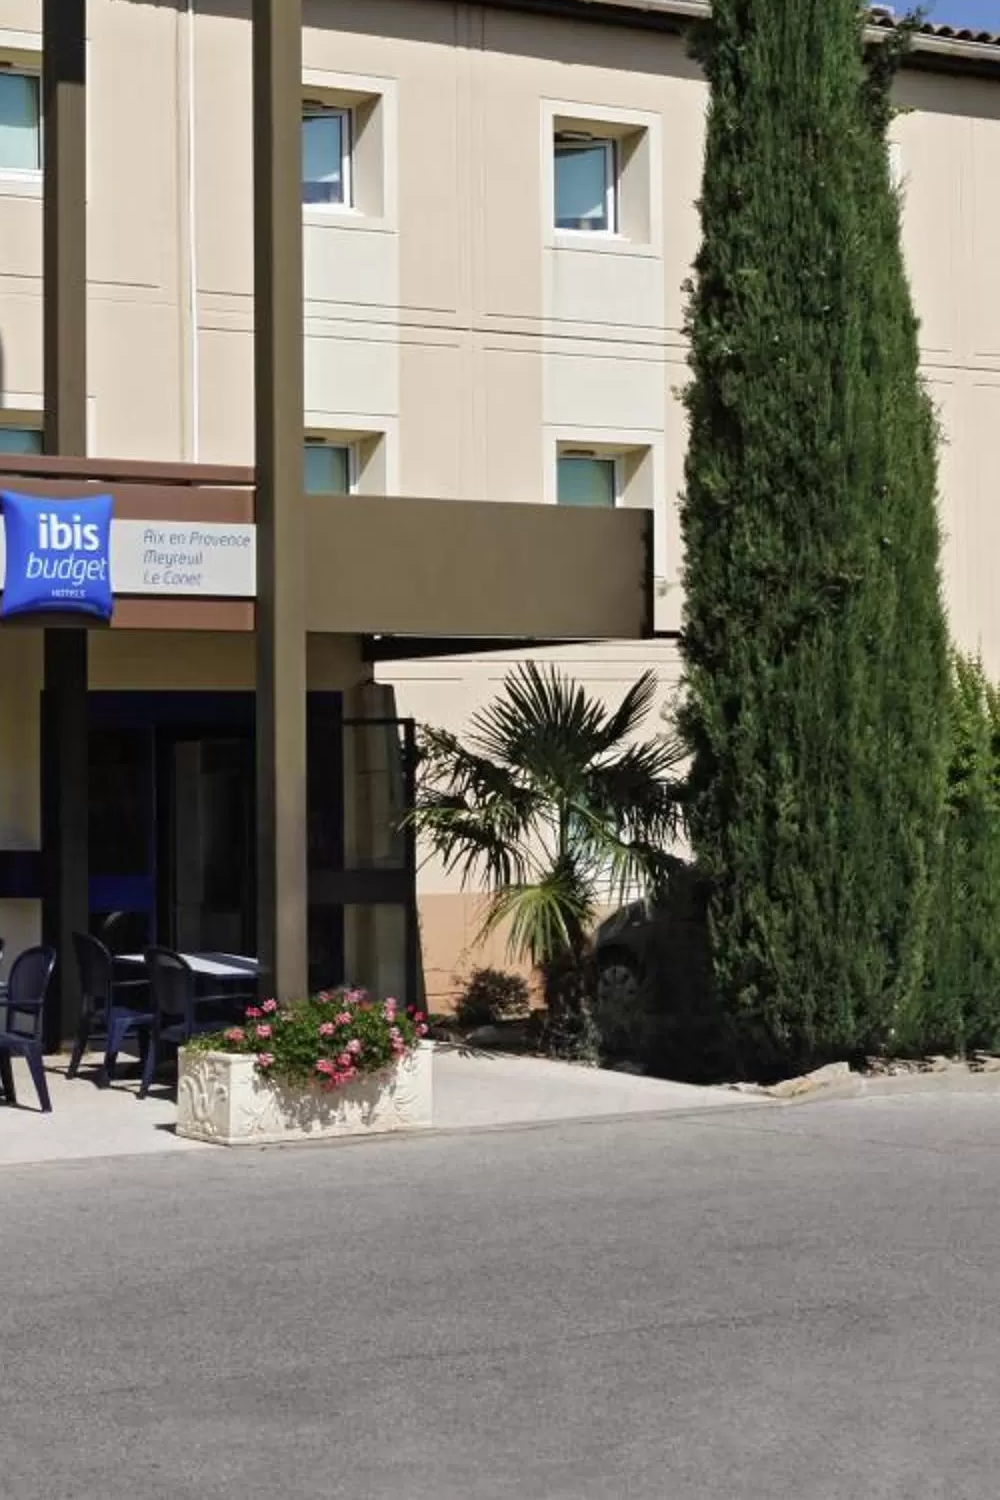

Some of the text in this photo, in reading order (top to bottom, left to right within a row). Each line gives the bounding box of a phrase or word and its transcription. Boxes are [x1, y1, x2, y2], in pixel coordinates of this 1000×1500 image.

[38, 513, 100, 551] ibis
[143, 528, 251, 547] Aix en Provence
[143, 548, 204, 568] Meyreuil
[25, 551, 108, 586] budget
[143, 568, 161, 585] Le
